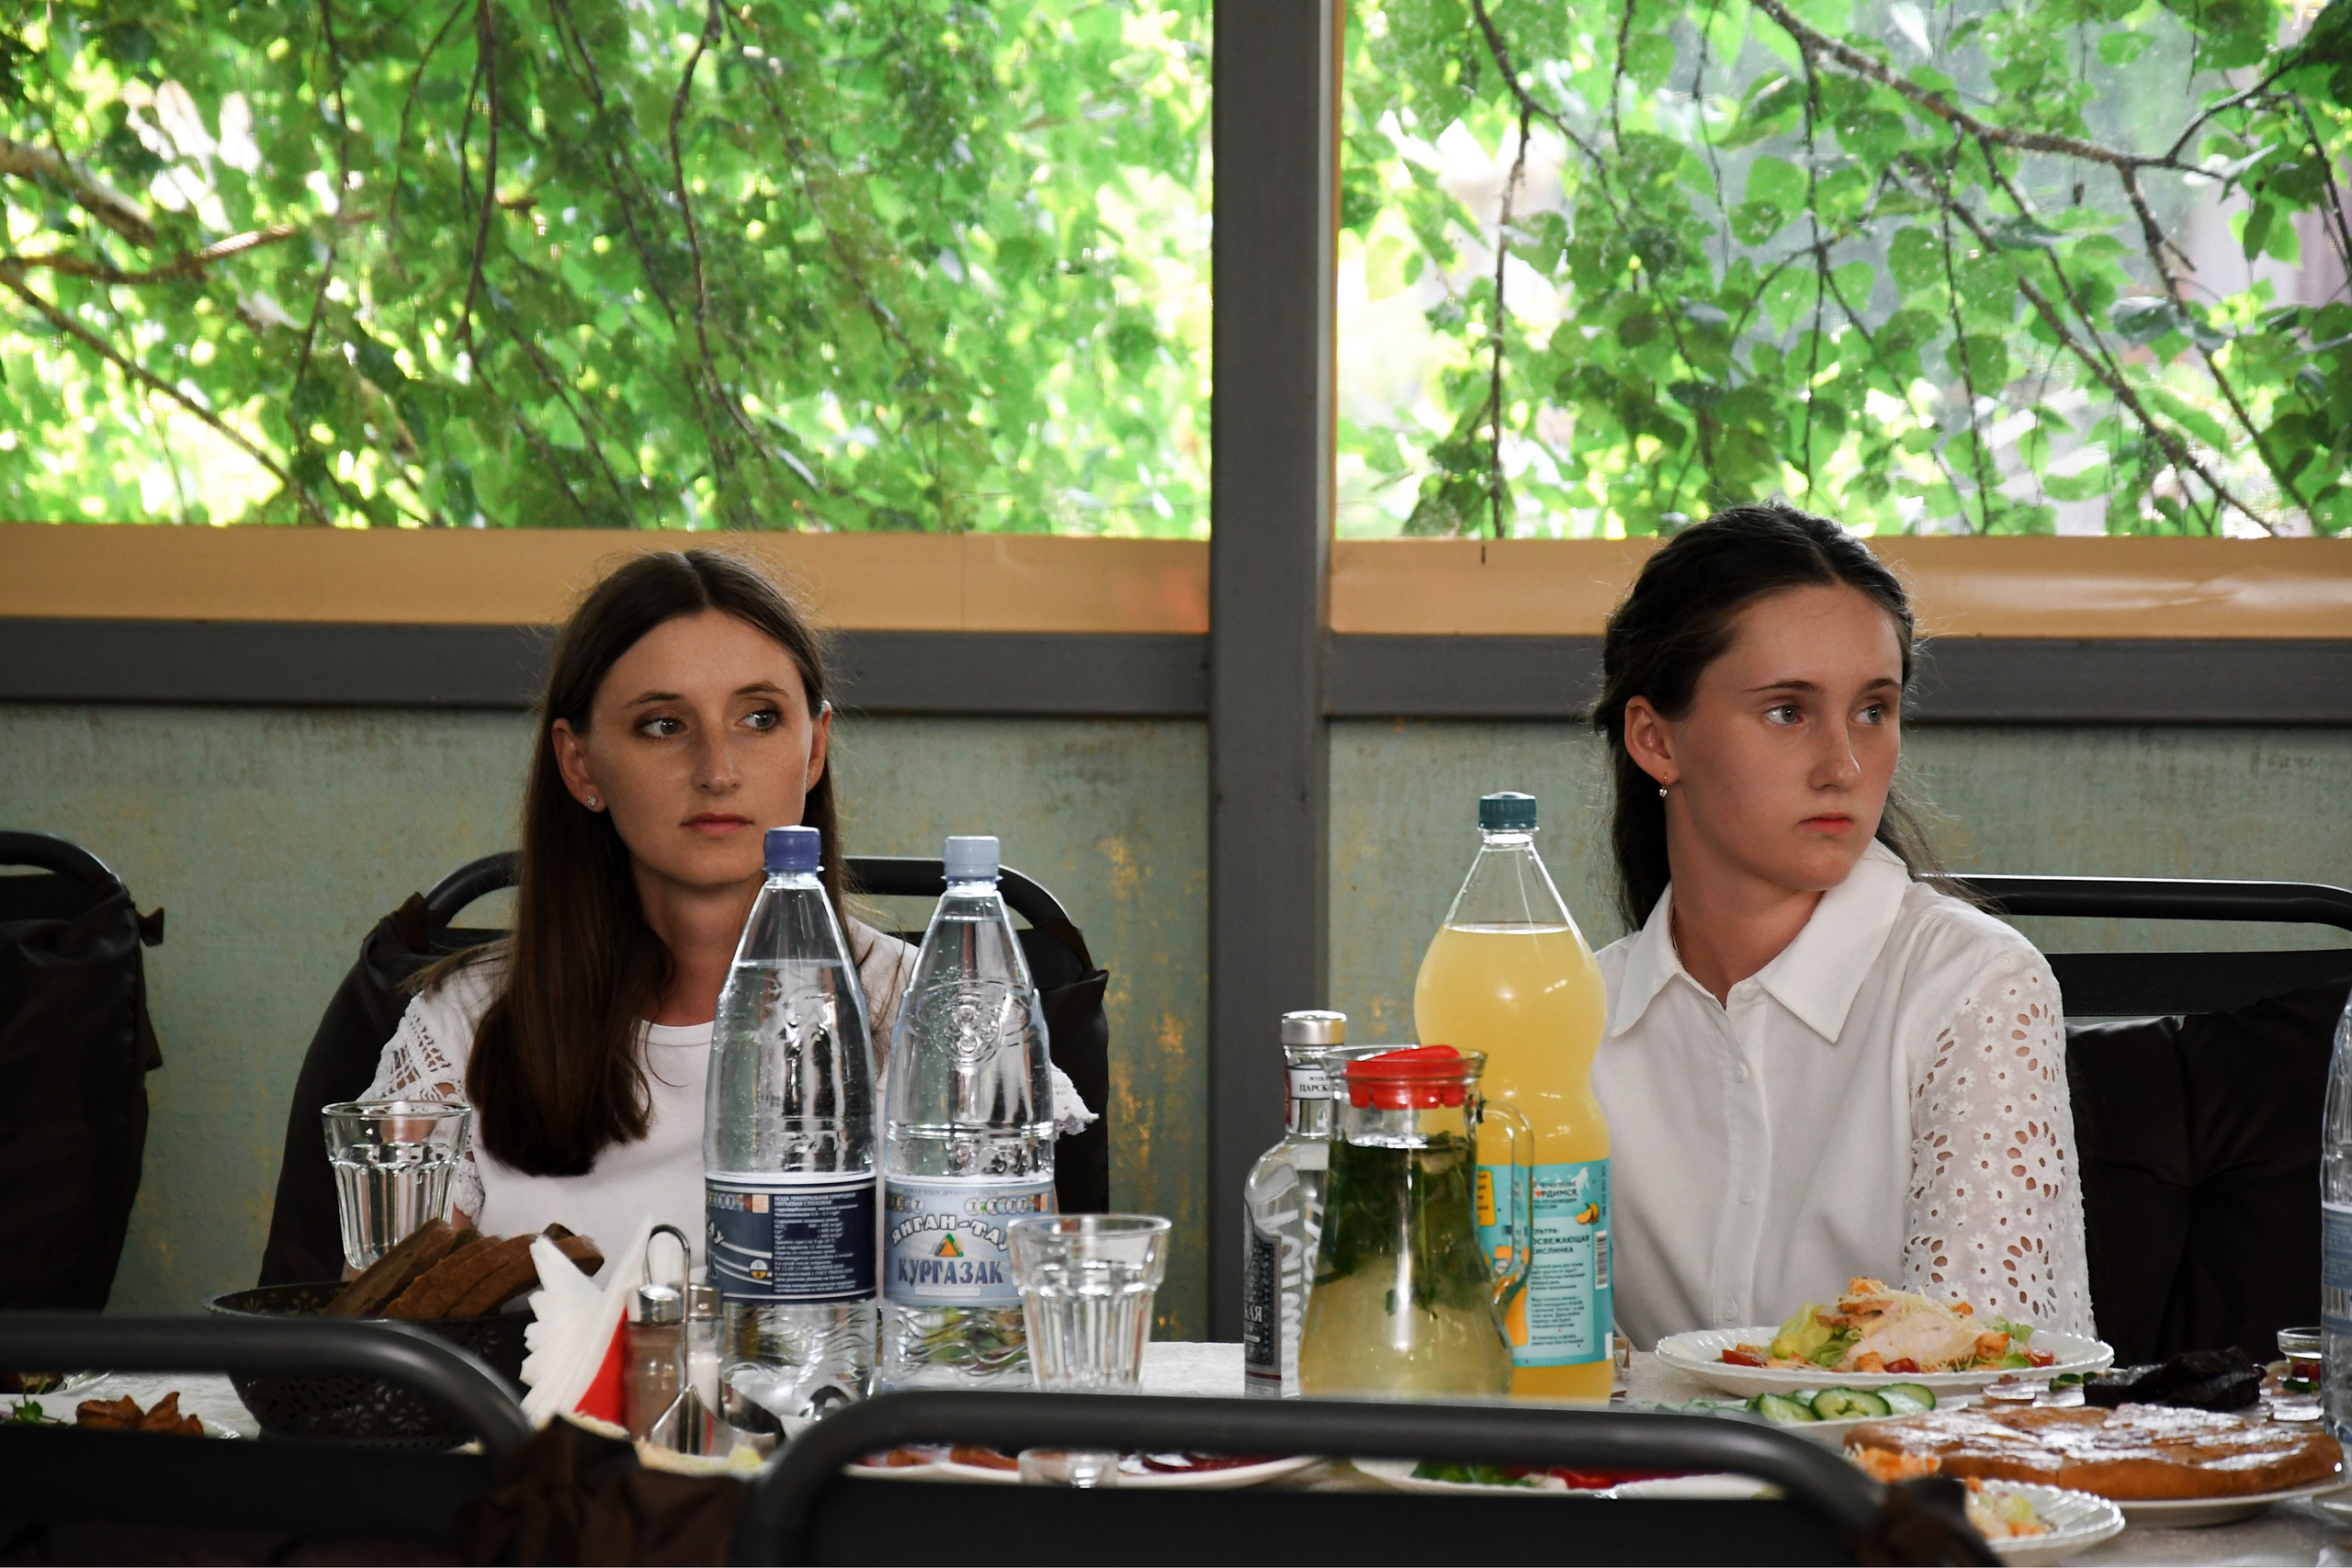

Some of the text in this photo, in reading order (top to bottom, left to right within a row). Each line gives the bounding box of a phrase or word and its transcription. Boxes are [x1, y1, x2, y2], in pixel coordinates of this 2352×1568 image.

[1299, 1084, 1329, 1092] ЦАРСК
[1535, 1188, 1577, 1198] РДИМСЯ
[891, 1213, 1009, 1252] ЯНГАН-ТА
[1532, 1247, 1574, 1255] ИСЛИНКА
[898, 1258, 1003, 1287] КУРГАЗАК
